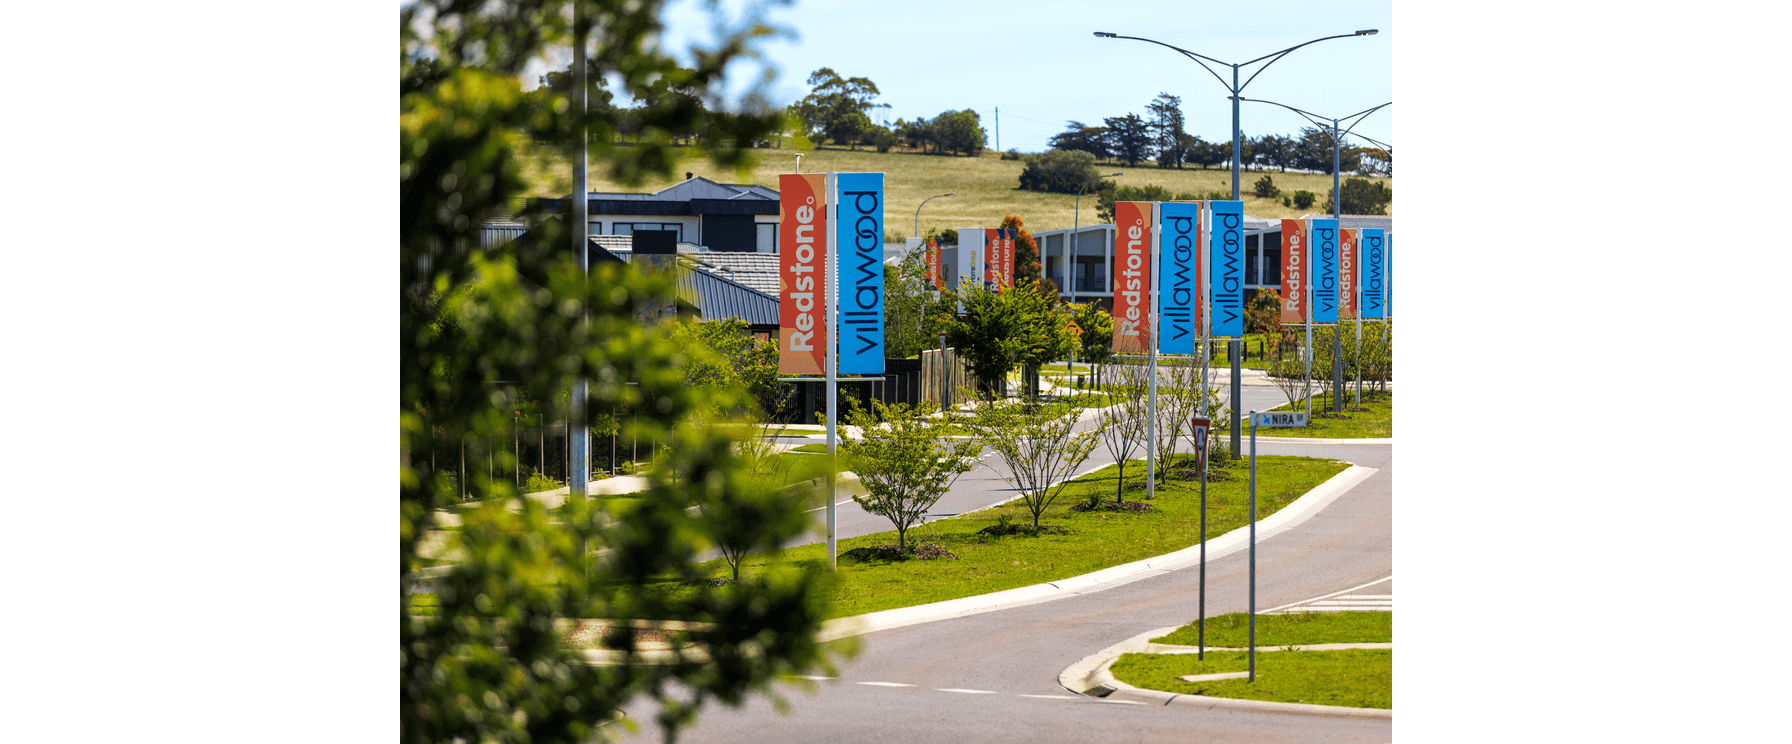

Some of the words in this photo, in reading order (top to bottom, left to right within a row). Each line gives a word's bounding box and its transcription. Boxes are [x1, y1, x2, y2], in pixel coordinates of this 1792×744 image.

[844, 191, 878, 355] villawood
[1164, 216, 1192, 340] villawood
[1215, 213, 1240, 324] villawood
[1315, 228, 1335, 313] villawood
[1365, 236, 1382, 310] villawood
[1272, 414, 1295, 425] NIRA
